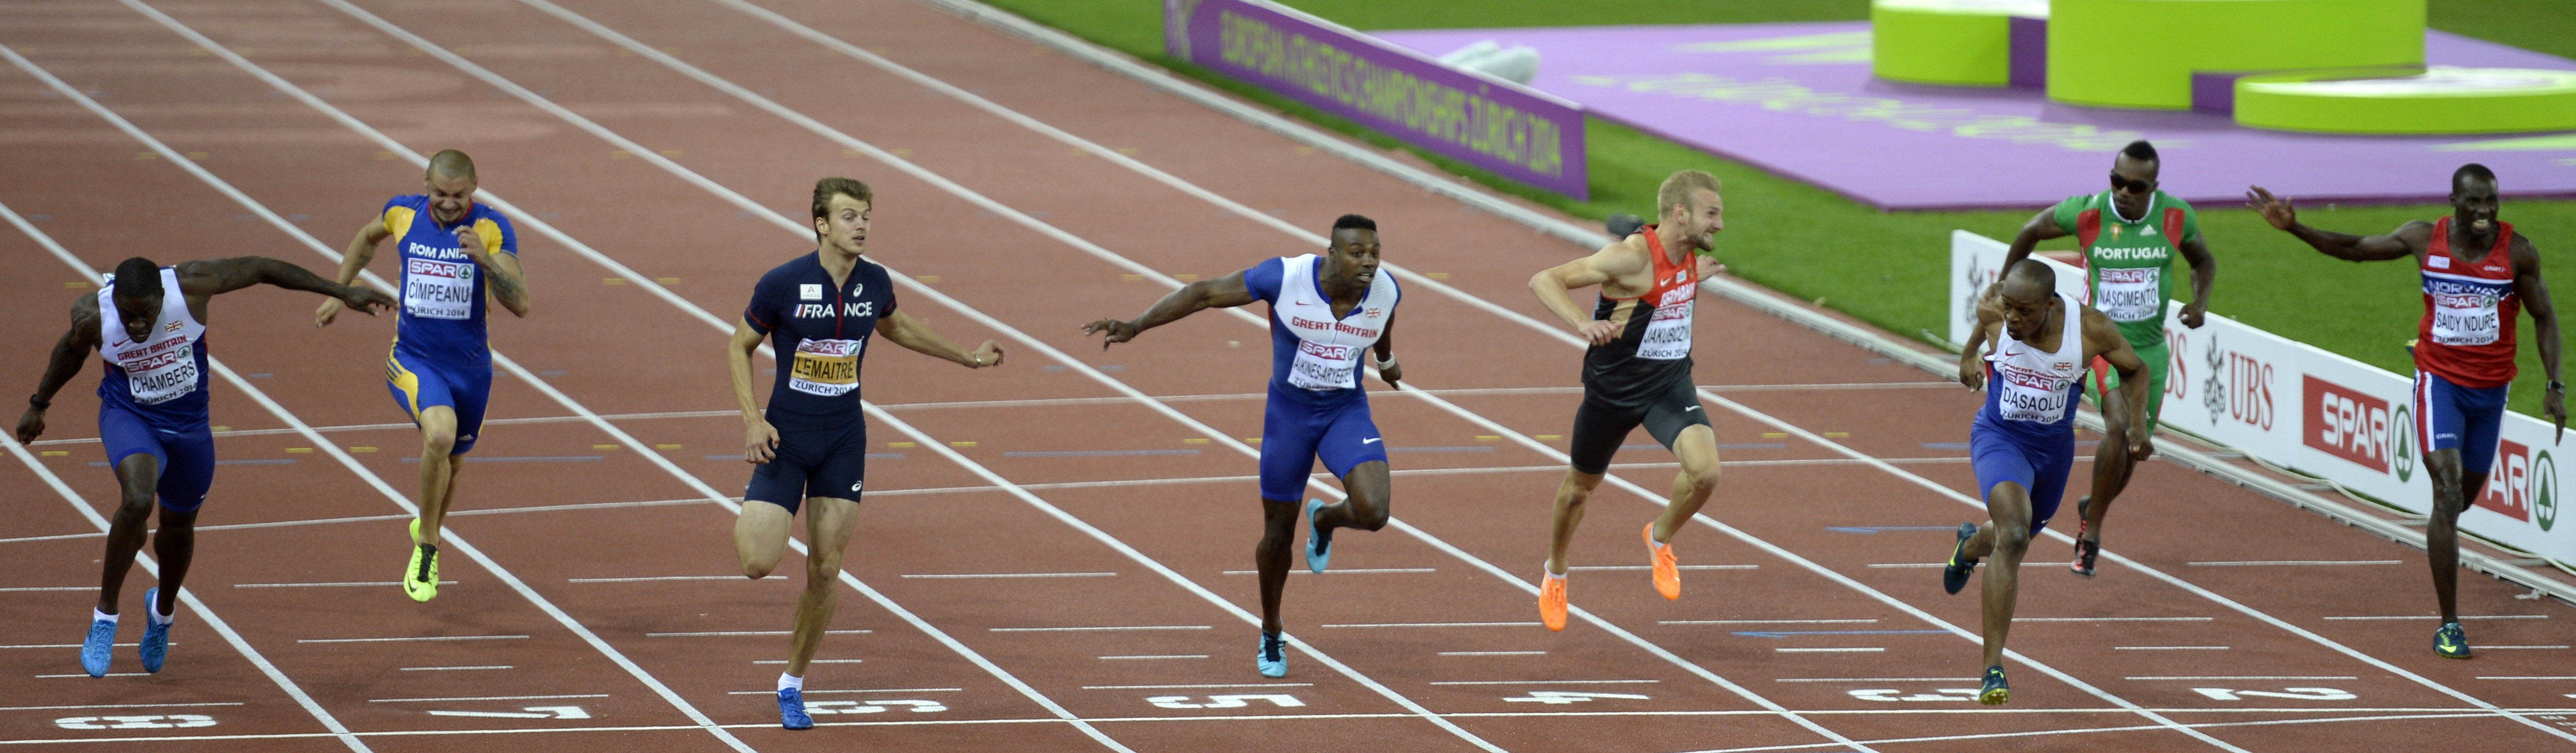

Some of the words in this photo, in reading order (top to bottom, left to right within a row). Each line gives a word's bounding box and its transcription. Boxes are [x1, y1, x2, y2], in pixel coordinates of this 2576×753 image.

[2094, 246, 2168, 260] PORTUGAL
[411, 261, 456, 277] SPAR
[2101, 270, 2144, 282] SPAR
[409, 278, 469, 303] CÎMPEANU
[2428, 279, 2502, 295] NORWAY
[2100, 288, 2157, 306] NASCIMENTO
[2437, 296, 2481, 308] SPAR
[409, 305, 443, 315] ÜRICH
[447, 308, 465, 317] 2014
[803, 301, 872, 318] FRANCE
[1653, 306, 1686, 320] SPAR
[2137, 309, 2153, 318] 2014
[1292, 316, 1332, 330] GREAT
[1335, 322, 1378, 338] BRITAIN
[2437, 311, 2462, 331] SAIDY
[2465, 312, 2497, 332] NDURE
[801, 339, 847, 354] SPAR
[2475, 334, 2494, 343] 2014
[117, 348, 148, 361] GREAT
[149, 334, 187, 354] BRITAIN
[1301, 340, 1346, 360] SPAR
[1642, 348, 1672, 357] ZÜRICH
[126, 352, 176, 371] SPAR
[795, 357, 854, 380] LEMAITRE
[2163, 328, 2187, 399] BS
[132, 361, 195, 394] CHAMBERS
[795, 377, 832, 394] ZÜRICH
[2006, 370, 2053, 390] SPAR
[2003, 386, 2065, 411] DASAOLU
[2230, 351, 2274, 431] UBS
[2002, 410, 2038, 420] ZÜRICH
[2042, 414, 2059, 422] 2014
[2322, 391, 2388, 463] SPAR
[2487, 451, 2528, 512] AR
[1144, 693, 1306, 709] 5
[55, 714, 217, 729] 8
